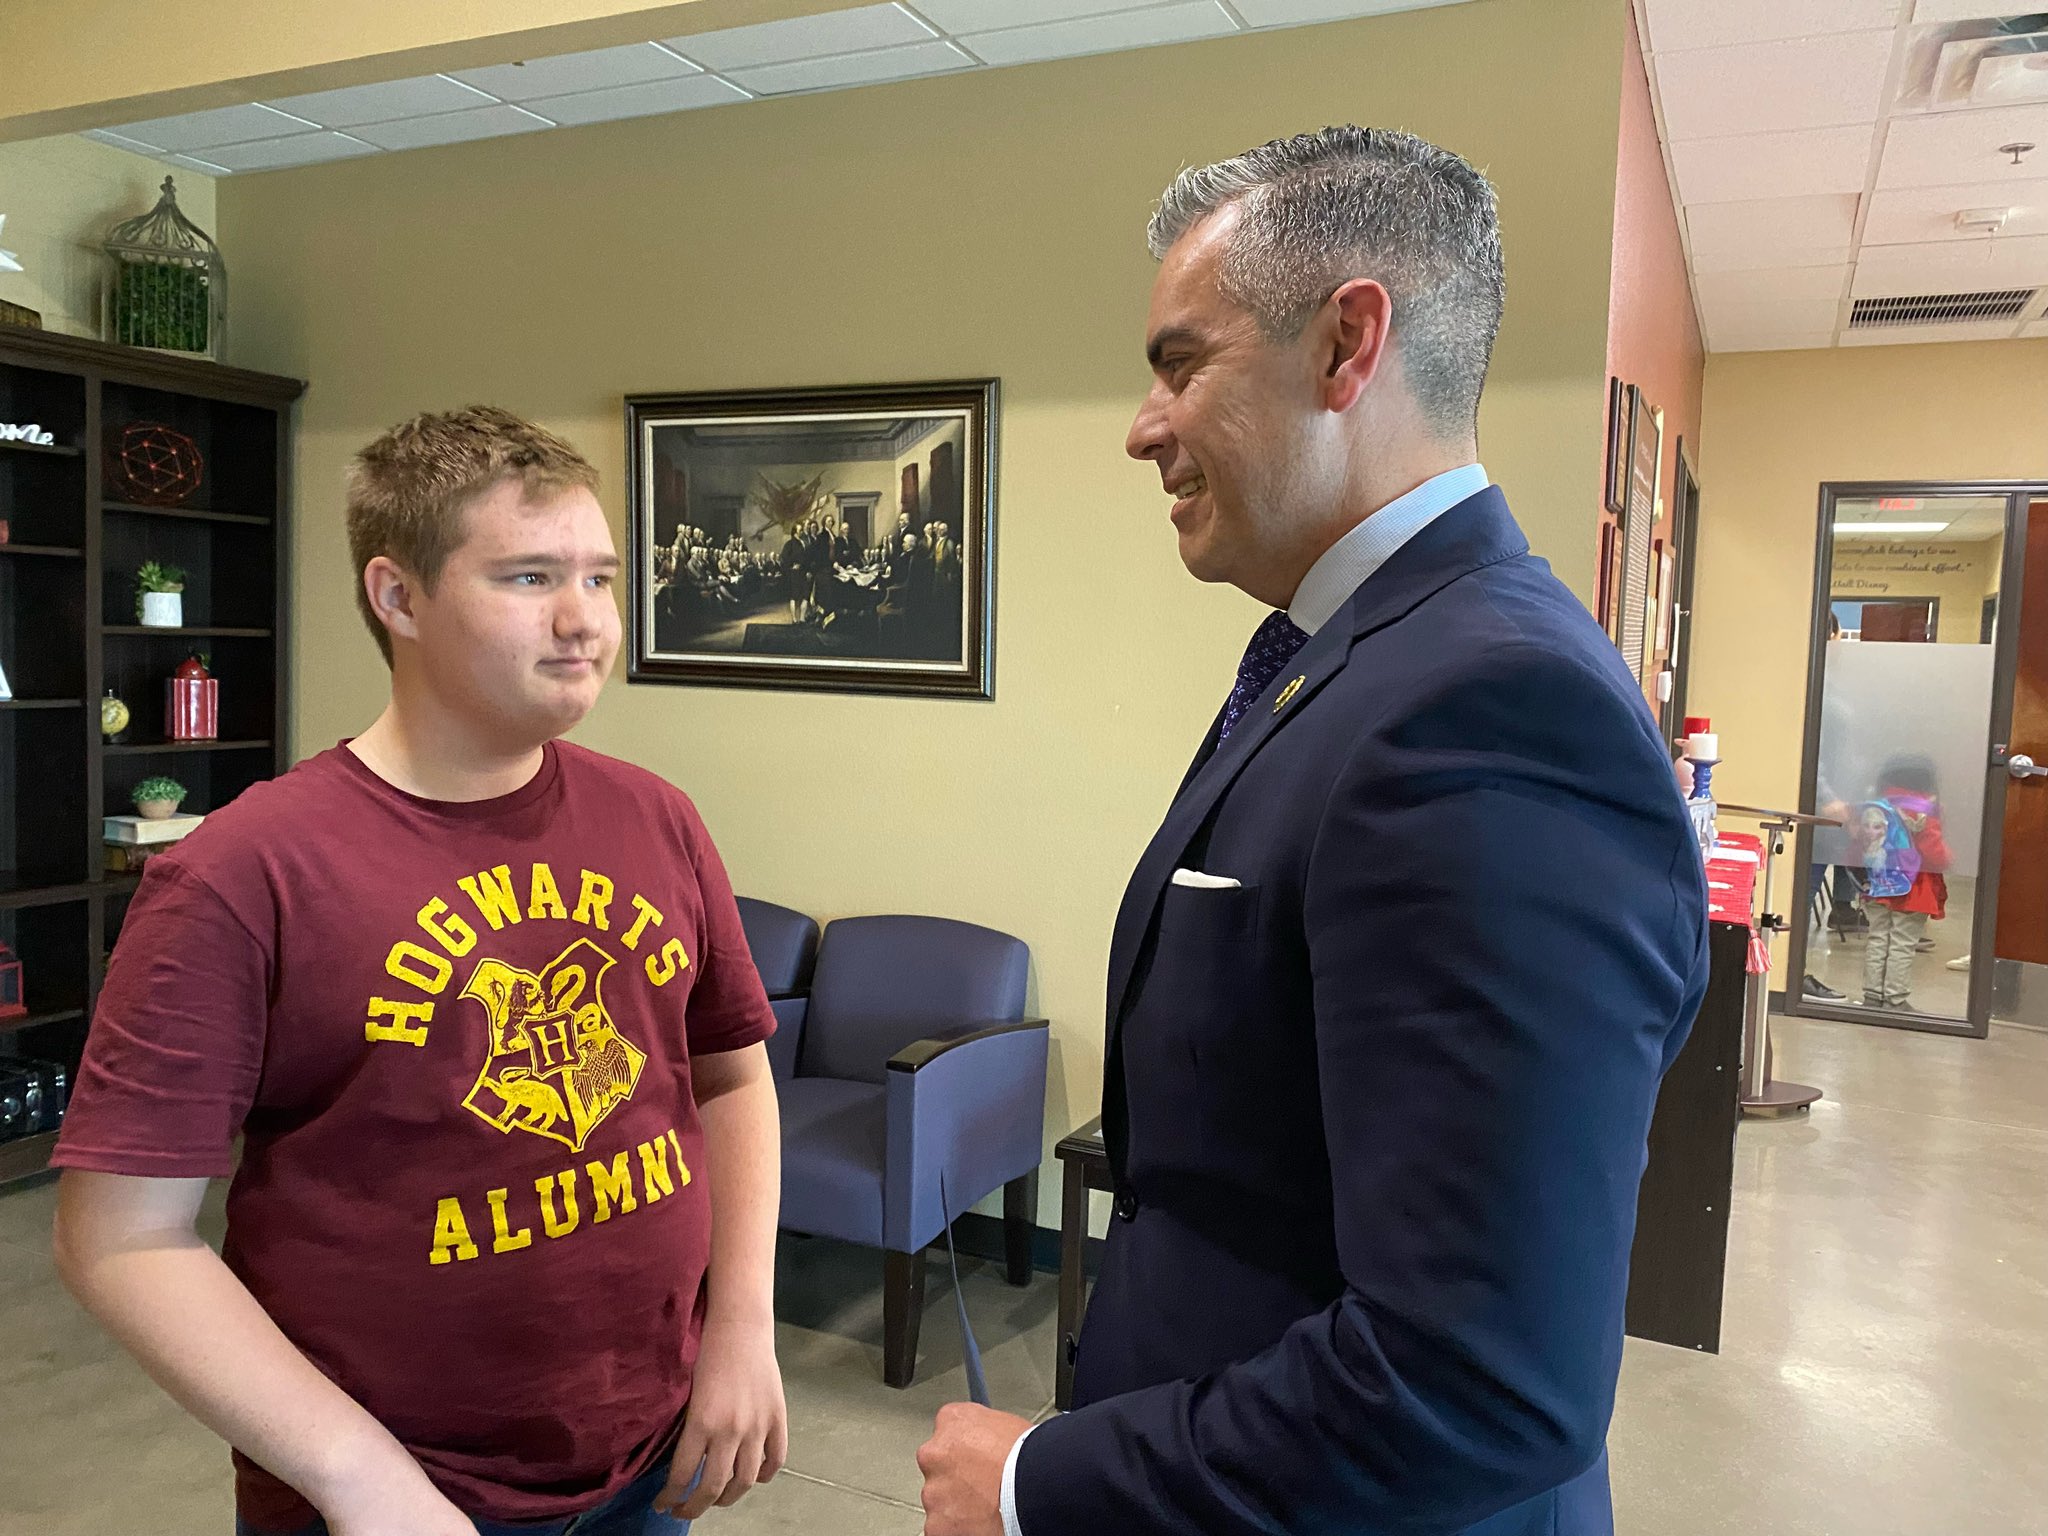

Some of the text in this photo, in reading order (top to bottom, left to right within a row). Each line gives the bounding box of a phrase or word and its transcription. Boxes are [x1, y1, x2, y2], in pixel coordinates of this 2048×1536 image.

[1887, 545, 1924, 558] belongs
[1926, 546, 1938, 555] to
[1856, 578, 1889, 592] Disney
[365, 863, 689, 1047] HOGWARTS
[531, 1020, 575, 1066] H
[429, 1129, 691, 1265] ALUMNI
